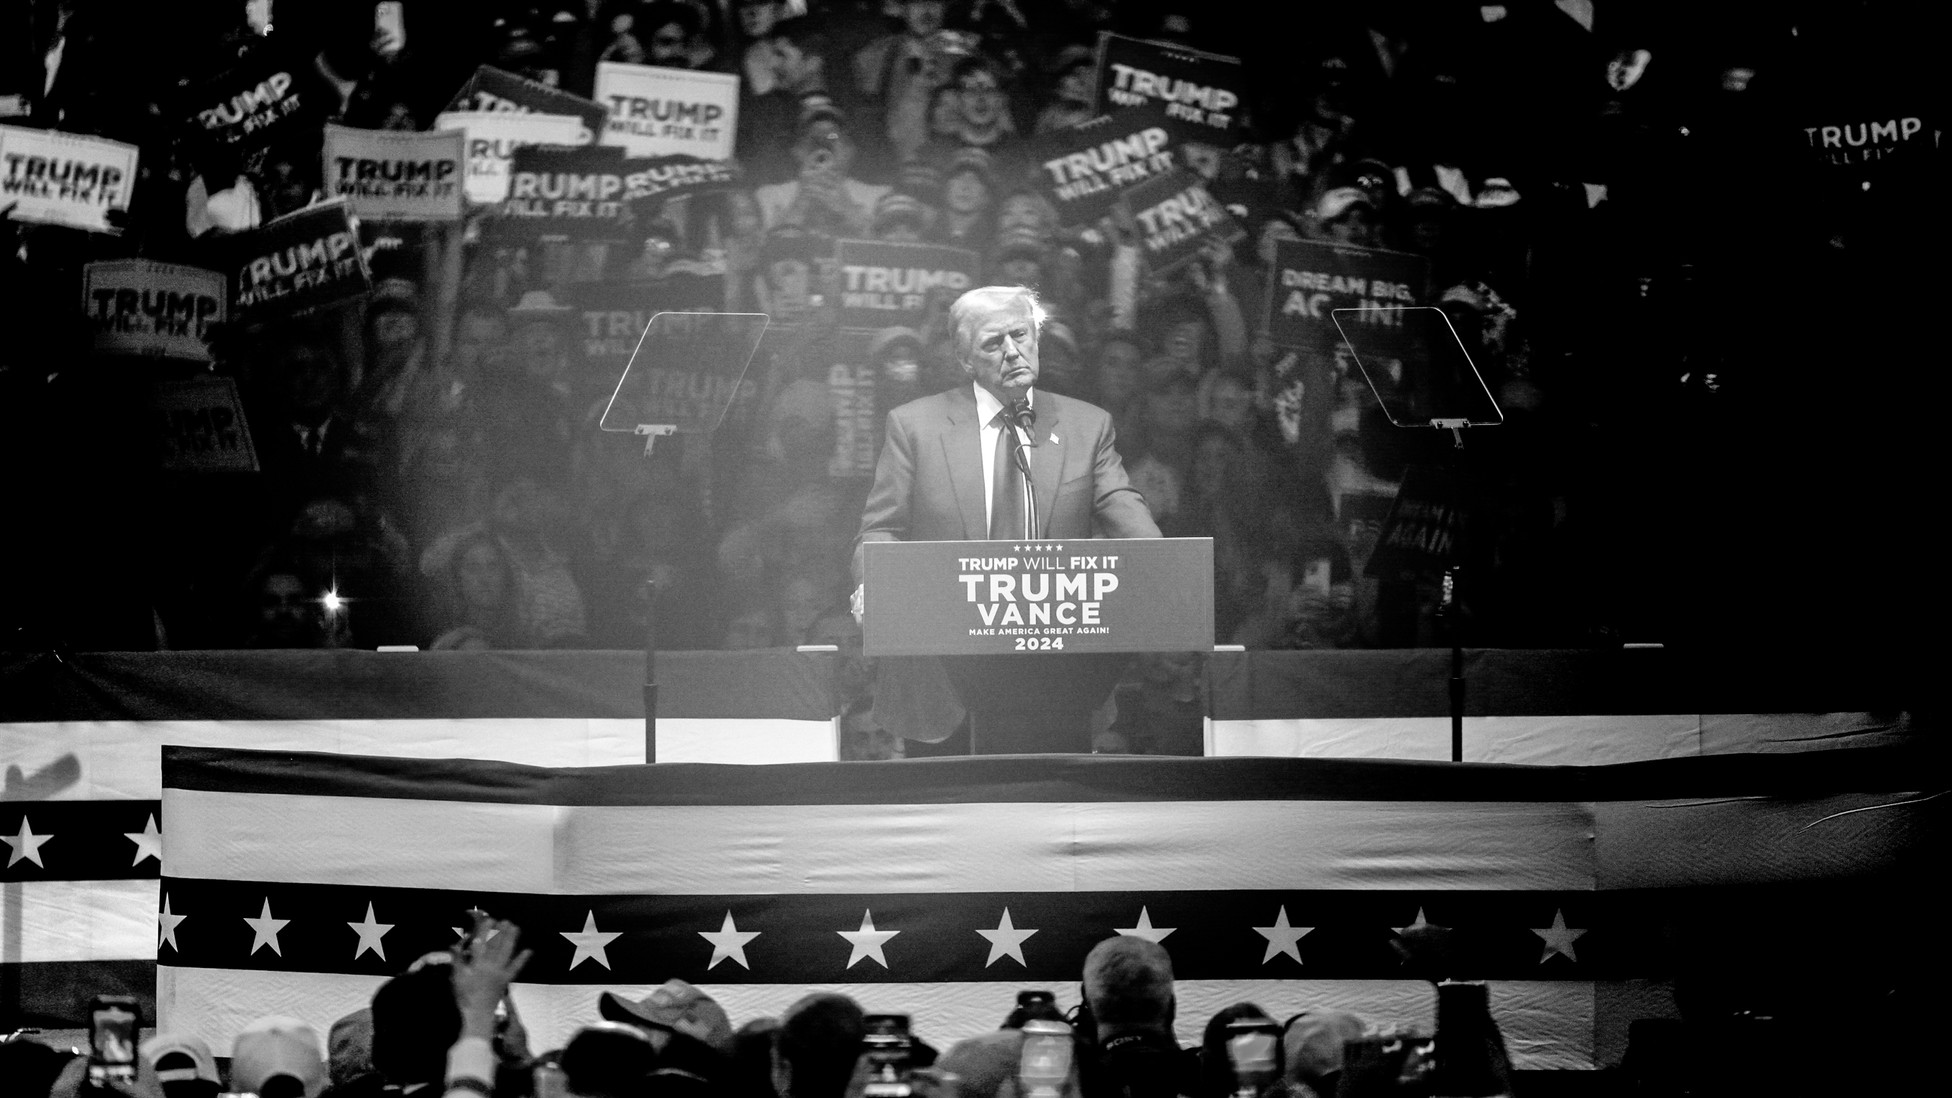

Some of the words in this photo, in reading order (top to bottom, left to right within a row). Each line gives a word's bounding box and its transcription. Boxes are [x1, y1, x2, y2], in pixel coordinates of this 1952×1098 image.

[1111, 63, 1238, 112] TRUMP
[609, 93, 723, 125] TRUMP
[1803, 116, 1922, 149] TRUMP
[4, 152, 124, 188] TRUMP
[335, 155, 456, 182] TRUMP
[1043, 127, 1169, 184] TRUMP
[514, 171, 622, 200] RUMP
[249, 231, 352, 286] RUMP
[841, 264, 973, 292] TRUMP
[1281, 267, 1368, 296] DREAM
[91, 287, 218, 325] TRUMP
[958, 557, 1018, 571] TRUMP
[1023, 556, 1065, 570] WILL
[1070, 556, 1098, 570] FIX
[1103, 555, 1119, 569] IT
[958, 572, 1119, 602] TRUMP
[976, 602, 1101, 626] VANCE
[969, 628, 996, 636] MAKE
[997, 627, 1041, 636] AMERICA
[1043, 627, 1074, 635] GREAT
[1076, 626, 1110, 635] AGAIN!
[1015, 636, 1064, 651] 2024
